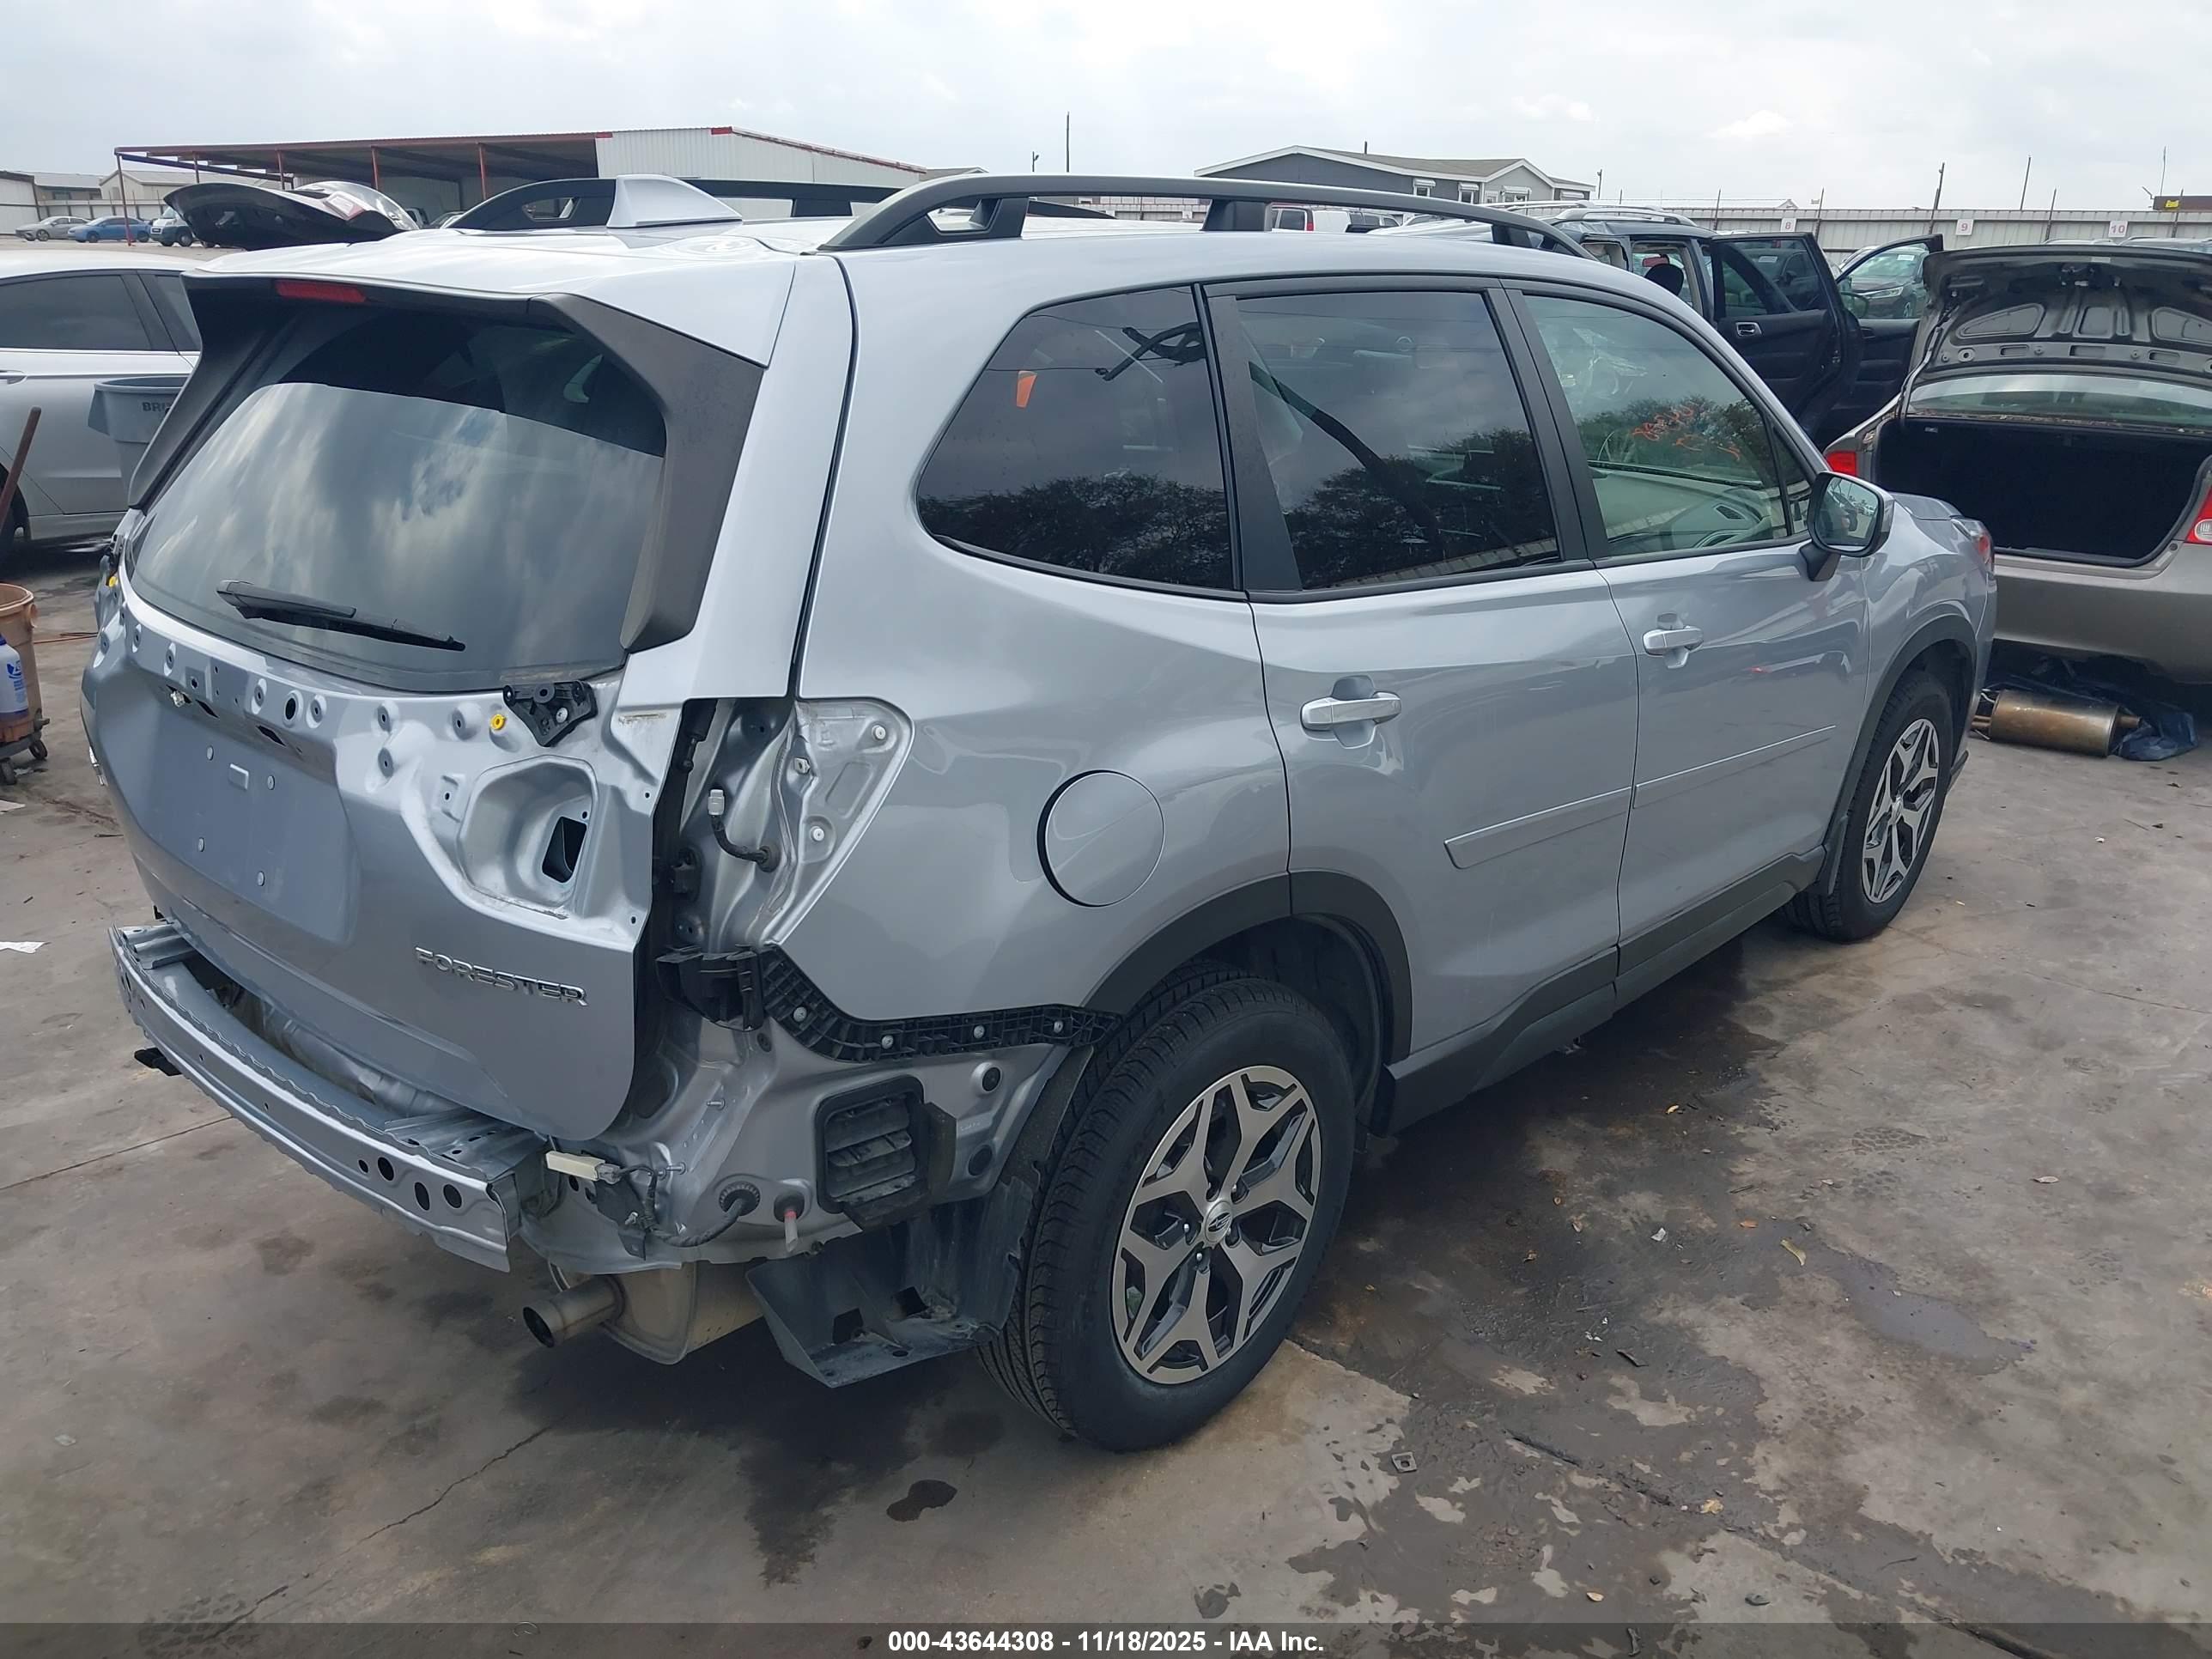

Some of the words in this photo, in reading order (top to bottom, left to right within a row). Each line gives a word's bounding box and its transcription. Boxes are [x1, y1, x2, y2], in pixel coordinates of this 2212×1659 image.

[1785, 222, 1791, 230] 8
[1960, 222, 1968, 232] 9
[2111, 224, 2125, 234] 10
[415, 946, 588, 1007] FORESTER
